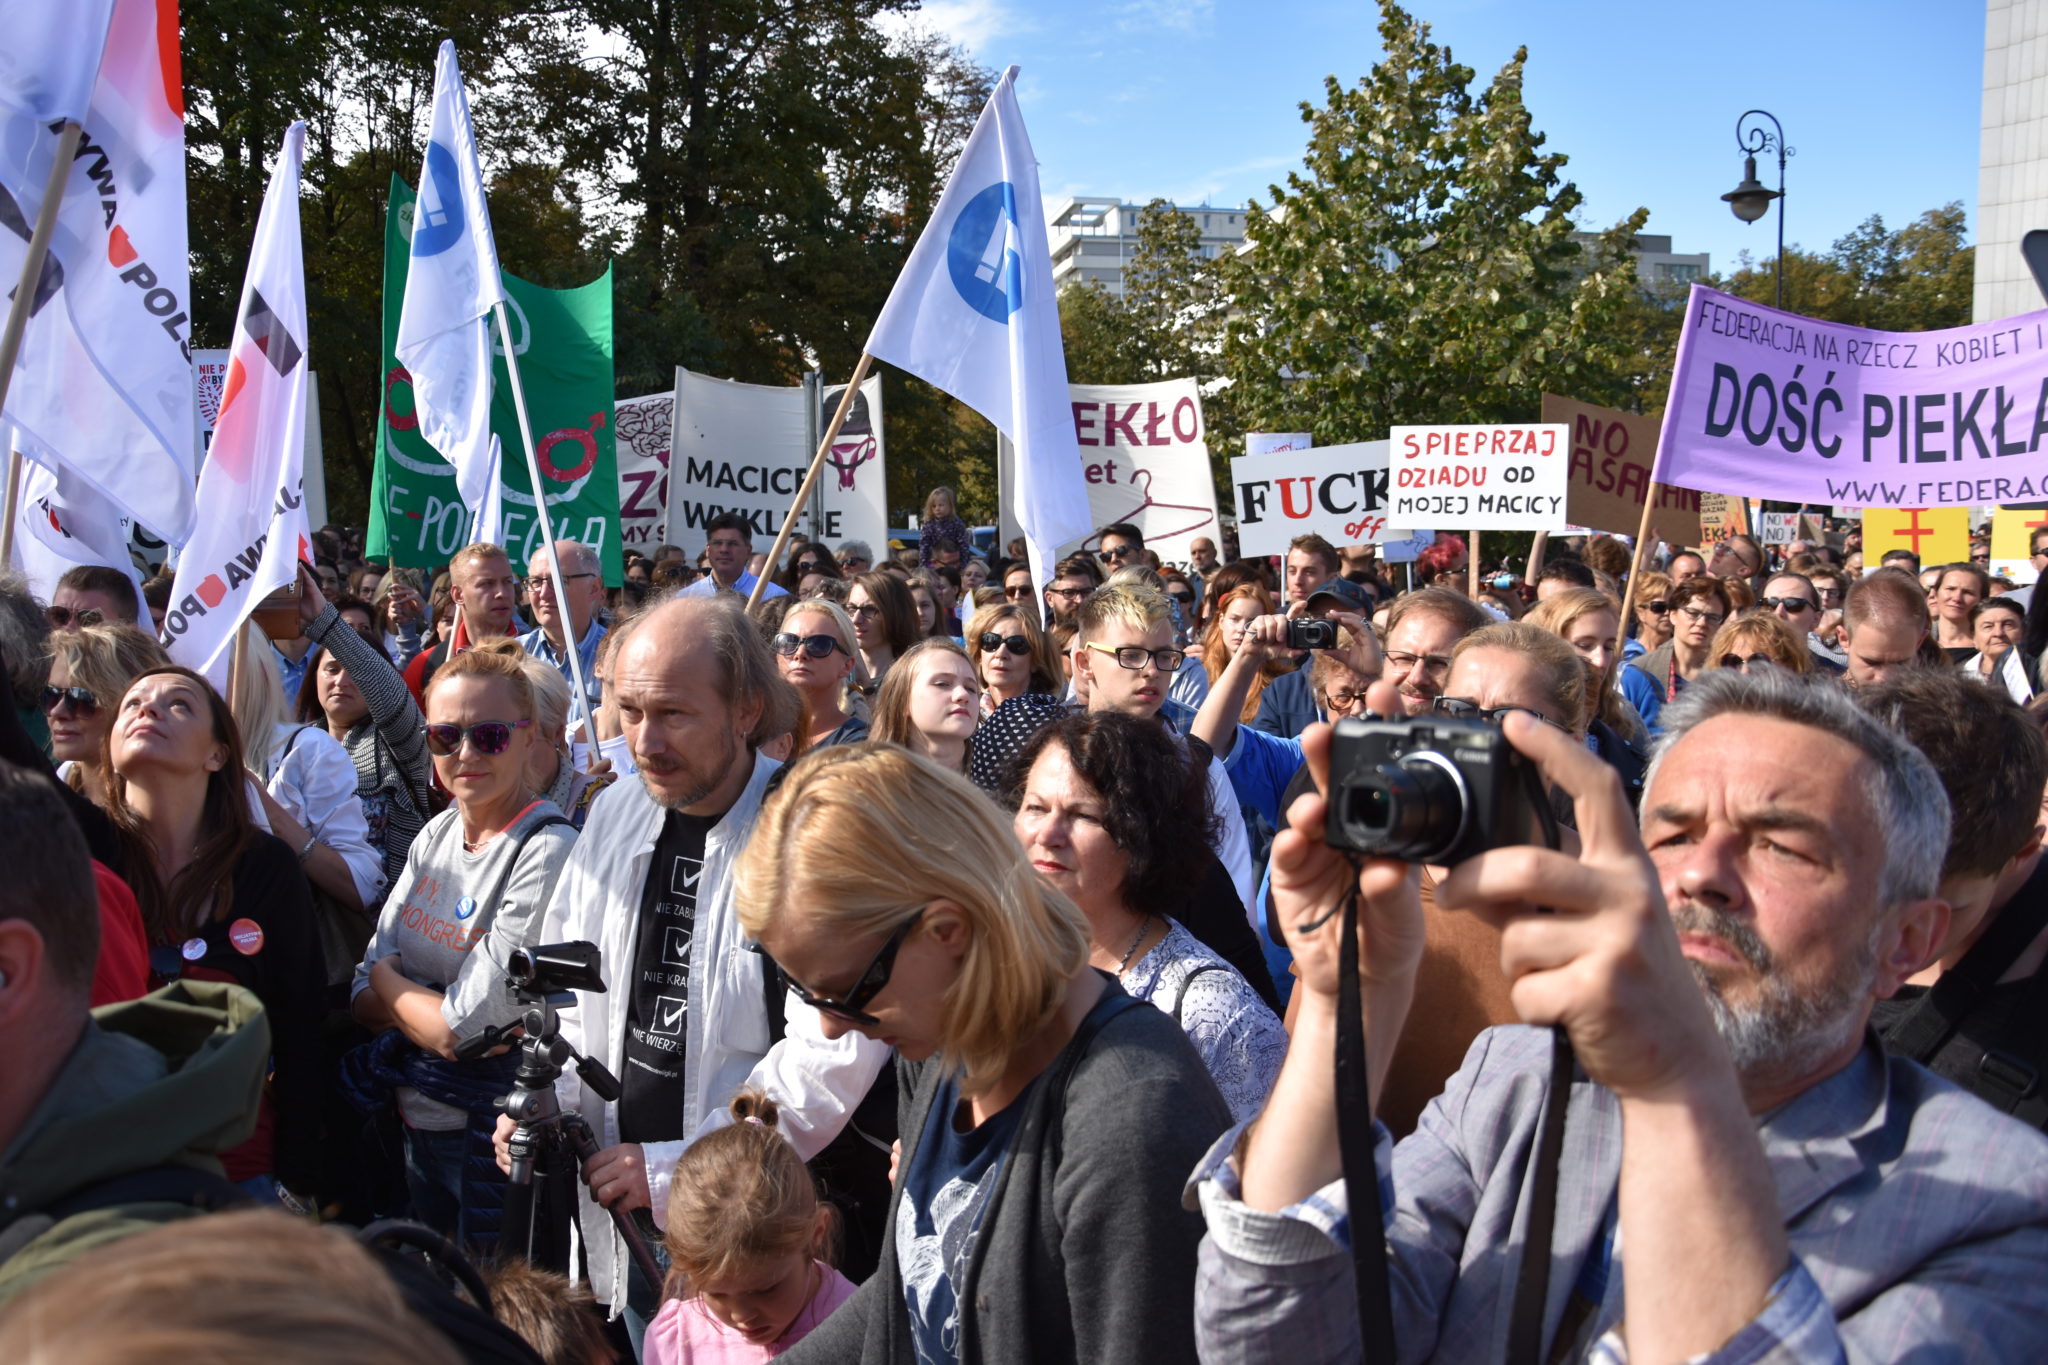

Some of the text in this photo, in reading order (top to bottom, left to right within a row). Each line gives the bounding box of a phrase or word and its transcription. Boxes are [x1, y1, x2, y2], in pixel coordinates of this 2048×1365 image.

[1698, 301, 1806, 356] FEDERACJA
[1814, 334, 1839, 362] NA
[1847, 339, 1918, 369] RZECZ
[1937, 328, 2022, 367] KOBIET
[1704, 363, 1843, 459] DOŚĆ
[1404, 429, 1555, 459] SPIEPRZAJ
[1575, 413, 1629, 457] NO
[1398, 465, 1535, 488] DZIADU OD
[1237, 467, 1389, 524] FUCK
[1398, 494, 1562, 514] MOJEJ MACICY
[1344, 515, 1387, 540] off
[1766, 528, 1784, 541] NO
[644, 970, 689, 988] NIE KRA
